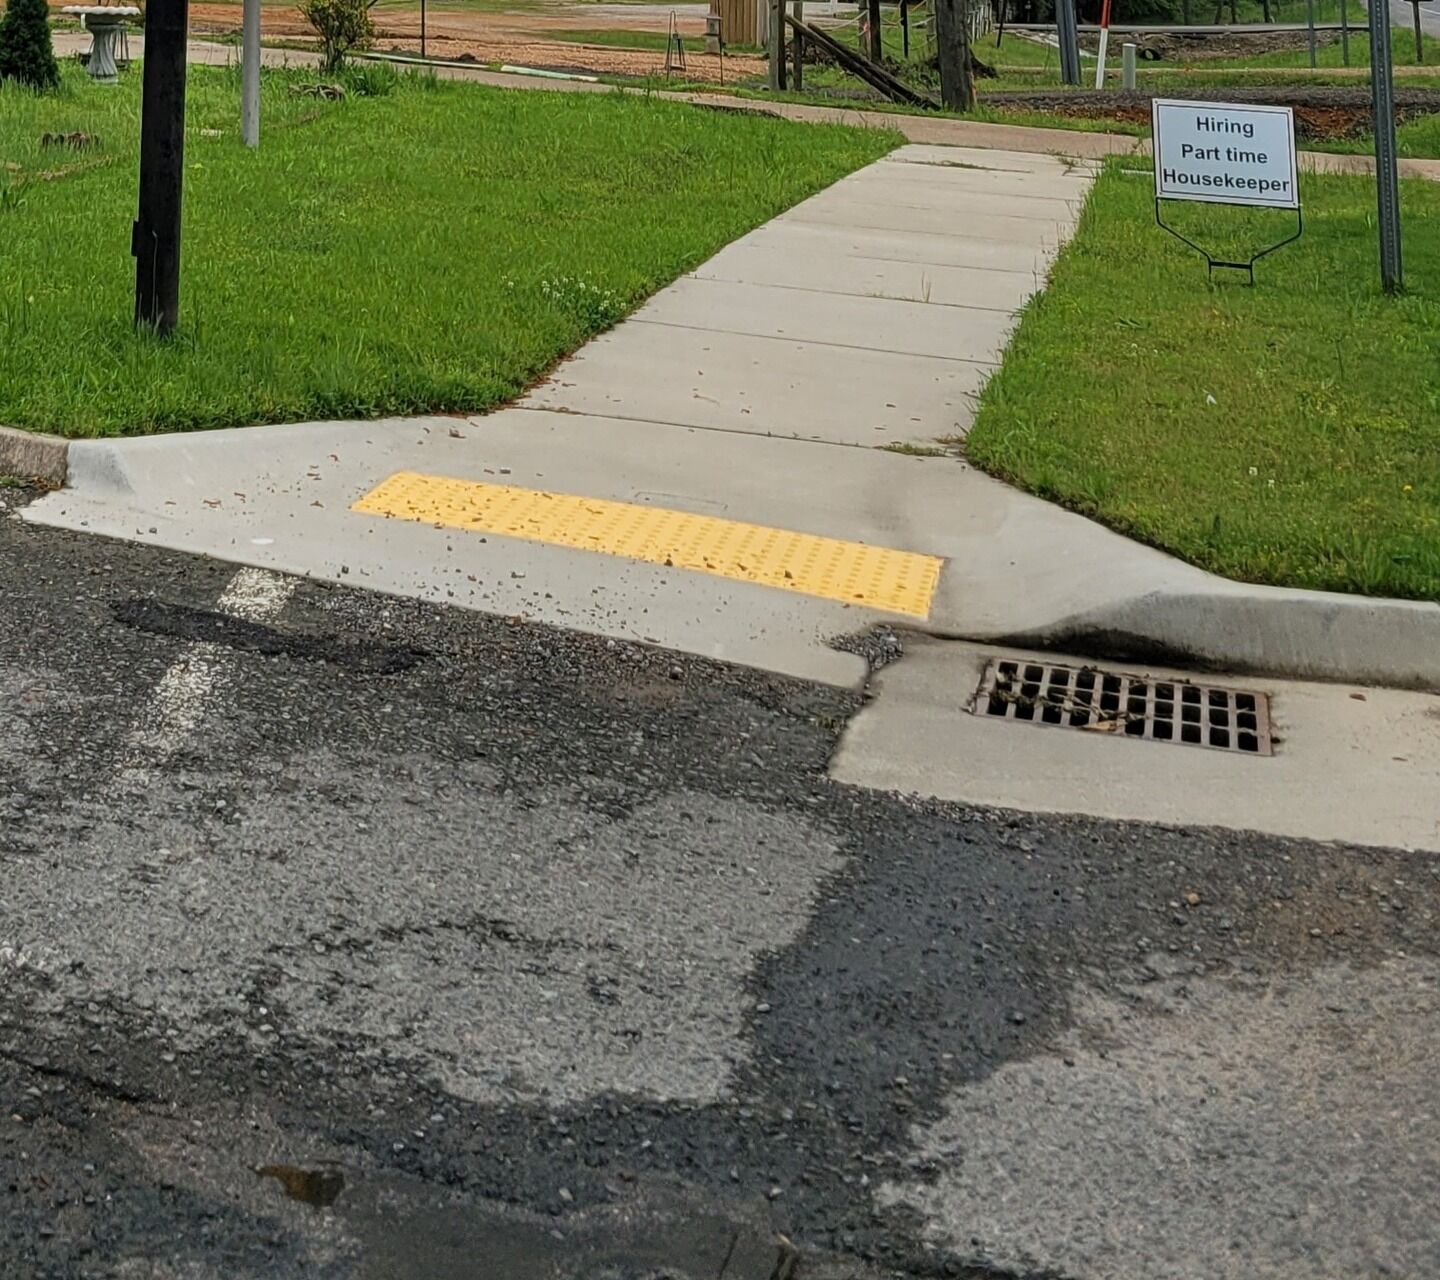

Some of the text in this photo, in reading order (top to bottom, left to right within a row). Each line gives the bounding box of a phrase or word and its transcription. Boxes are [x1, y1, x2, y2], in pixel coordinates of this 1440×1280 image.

[1196, 116, 1254, 138] Hiring
[1181, 143, 1268, 164] Part time
[1163, 168, 1290, 194] Housekeeper
